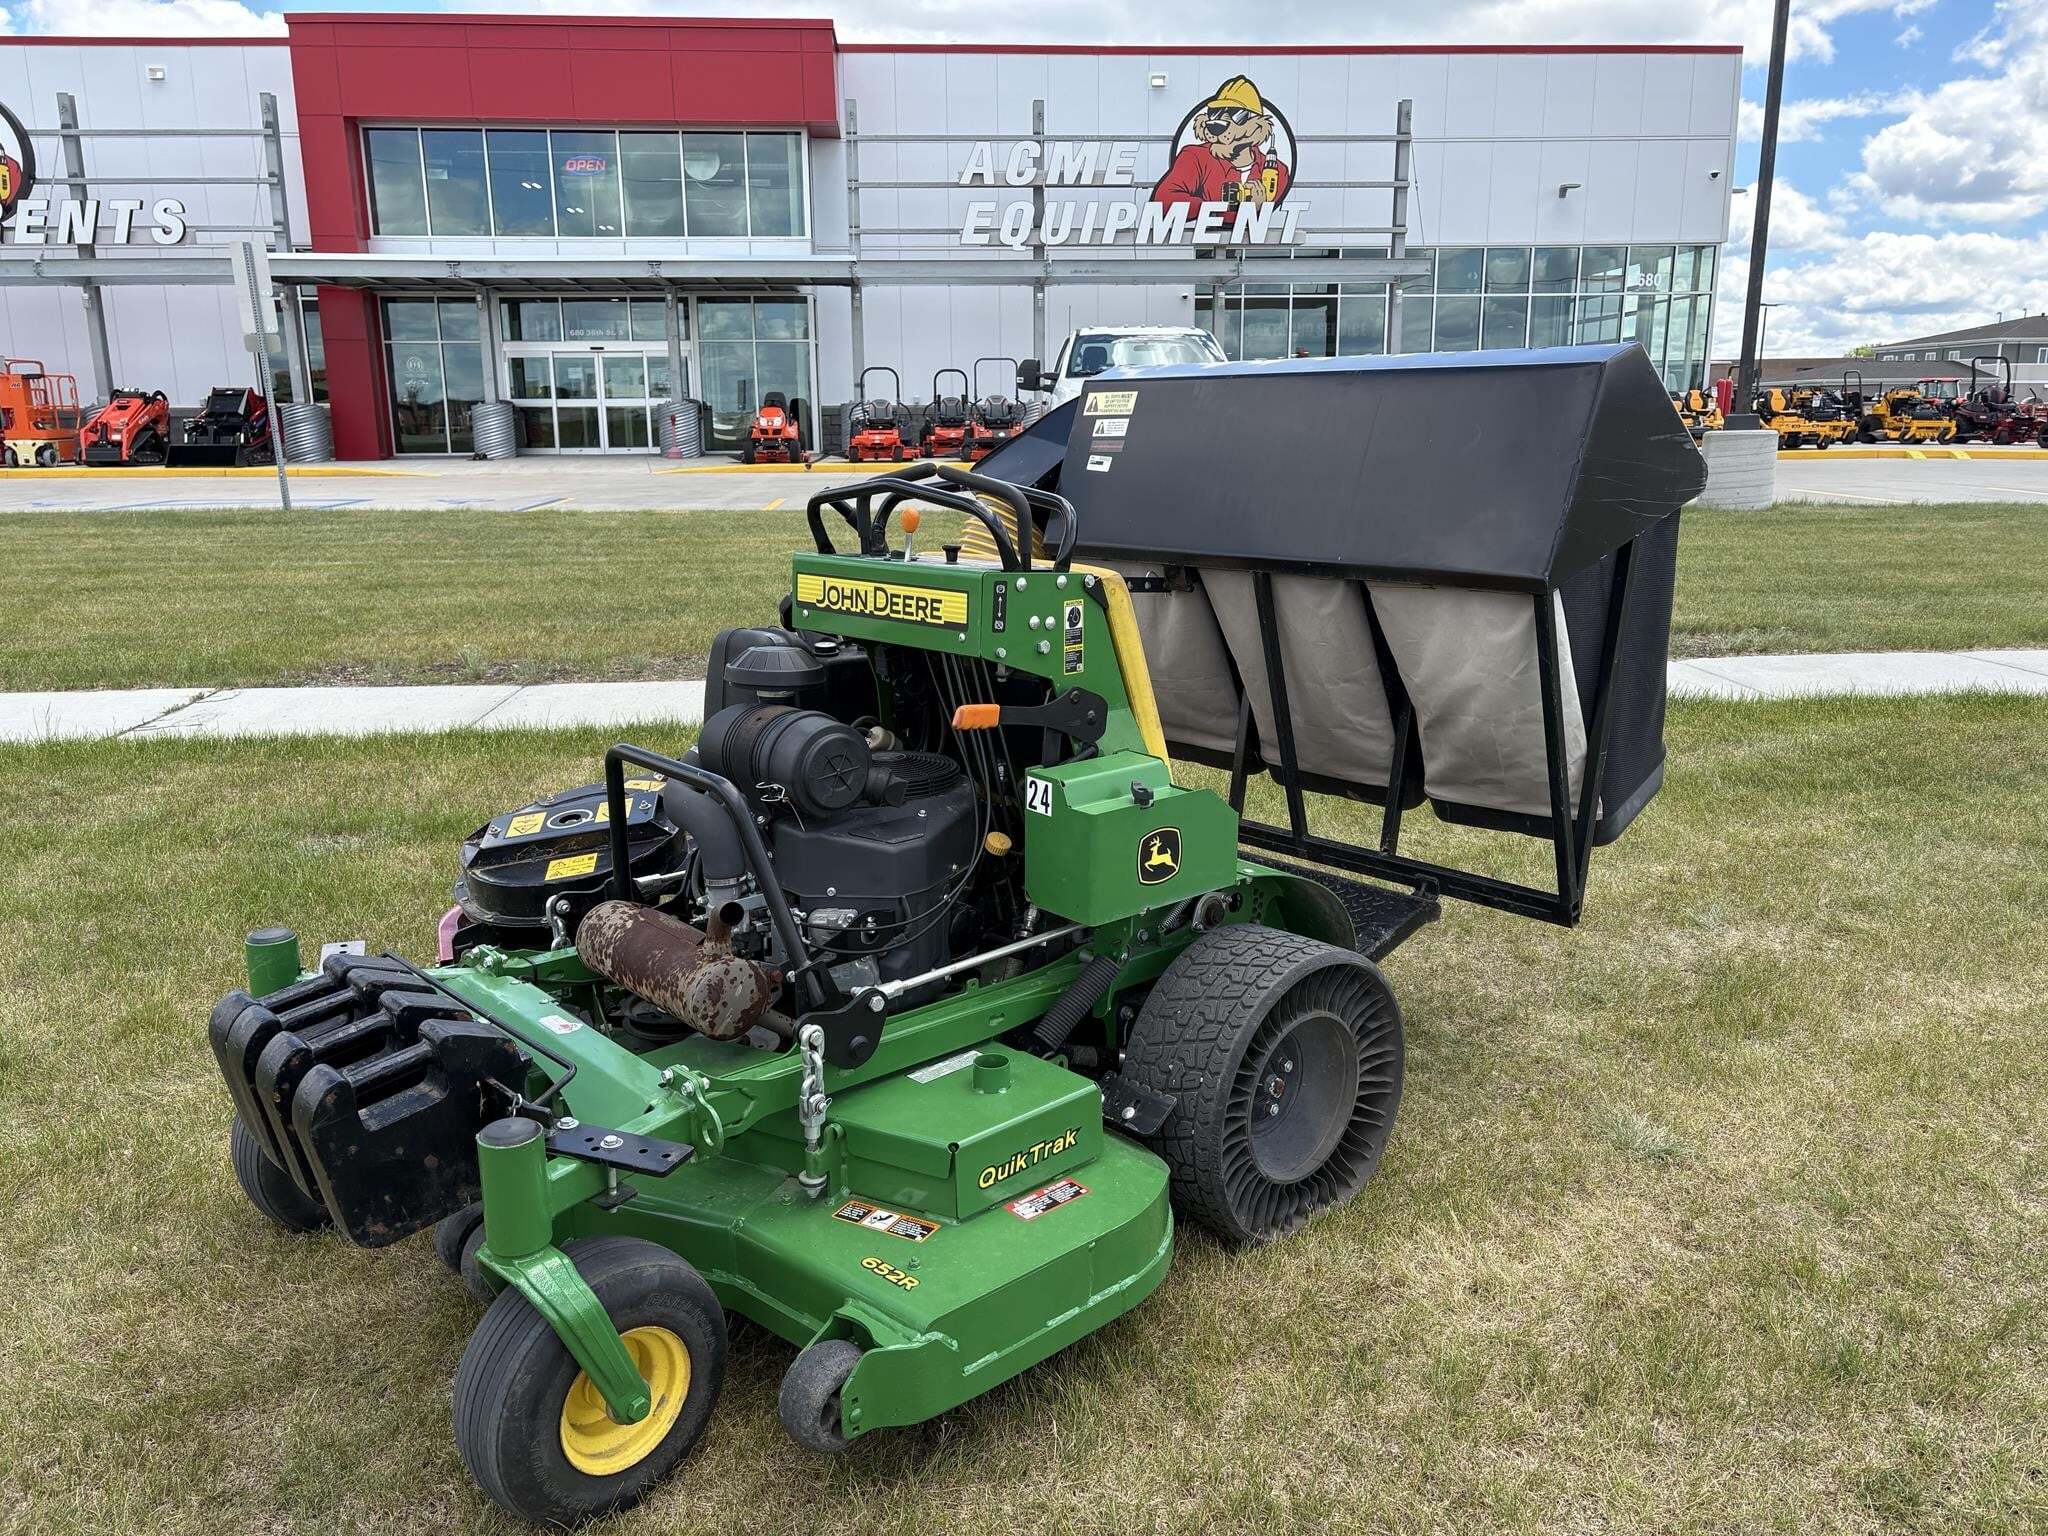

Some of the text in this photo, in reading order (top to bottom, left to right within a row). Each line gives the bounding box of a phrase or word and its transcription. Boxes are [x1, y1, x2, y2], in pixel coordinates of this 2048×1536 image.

[565, 160, 606, 171] OPEN
[958, 140, 1142, 187] ACME
[0, 199, 187, 245] ENTS
[959, 200, 1311, 250] EQUIPMENT
[1638, 272, 1662, 287] 680
[815, 579, 944, 622] JOHN DEERE
[1028, 780, 1050, 814] 24
[861, 1256, 921, 1292] 652R
